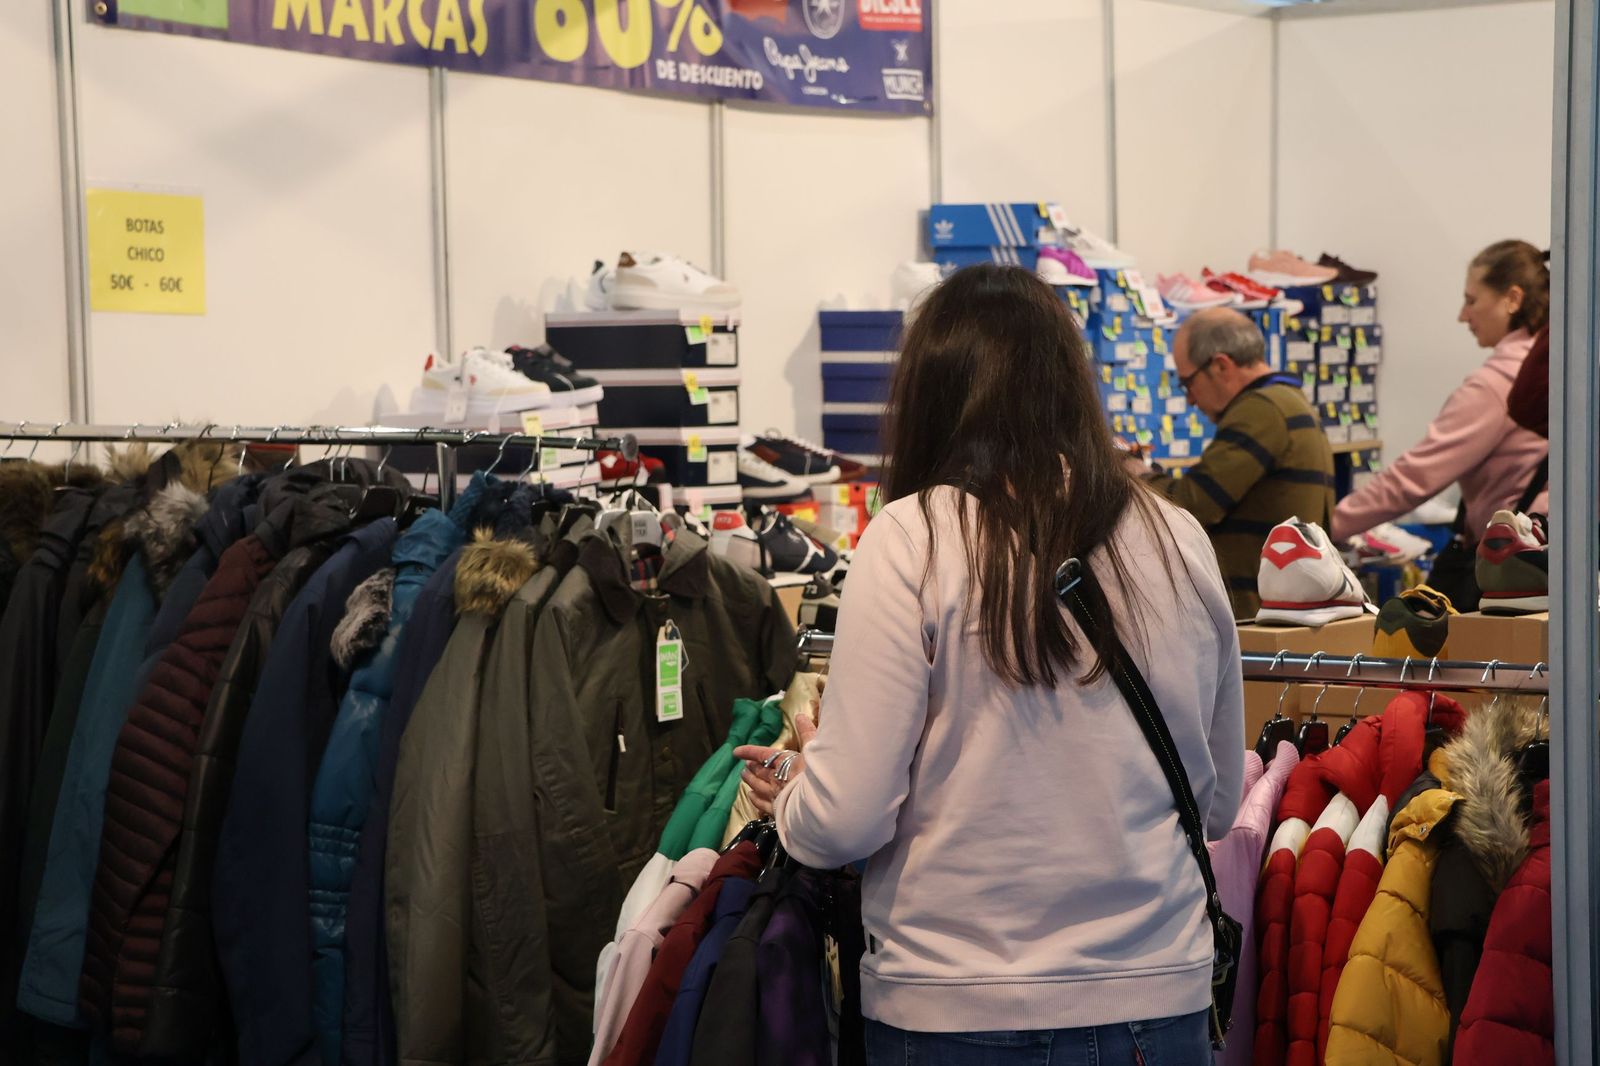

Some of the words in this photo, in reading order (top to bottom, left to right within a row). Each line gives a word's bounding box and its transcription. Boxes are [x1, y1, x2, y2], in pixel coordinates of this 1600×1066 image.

[272, 0, 489, 57] MARCAS
[656, 59, 677, 80] DE
[679, 64, 764, 90] DESCUENTO
[126, 217, 165, 235] BOTAS
[127, 246, 165, 262] CHICO
[110, 274, 135, 291] 50€
[159, 276, 184, 293] 60€
